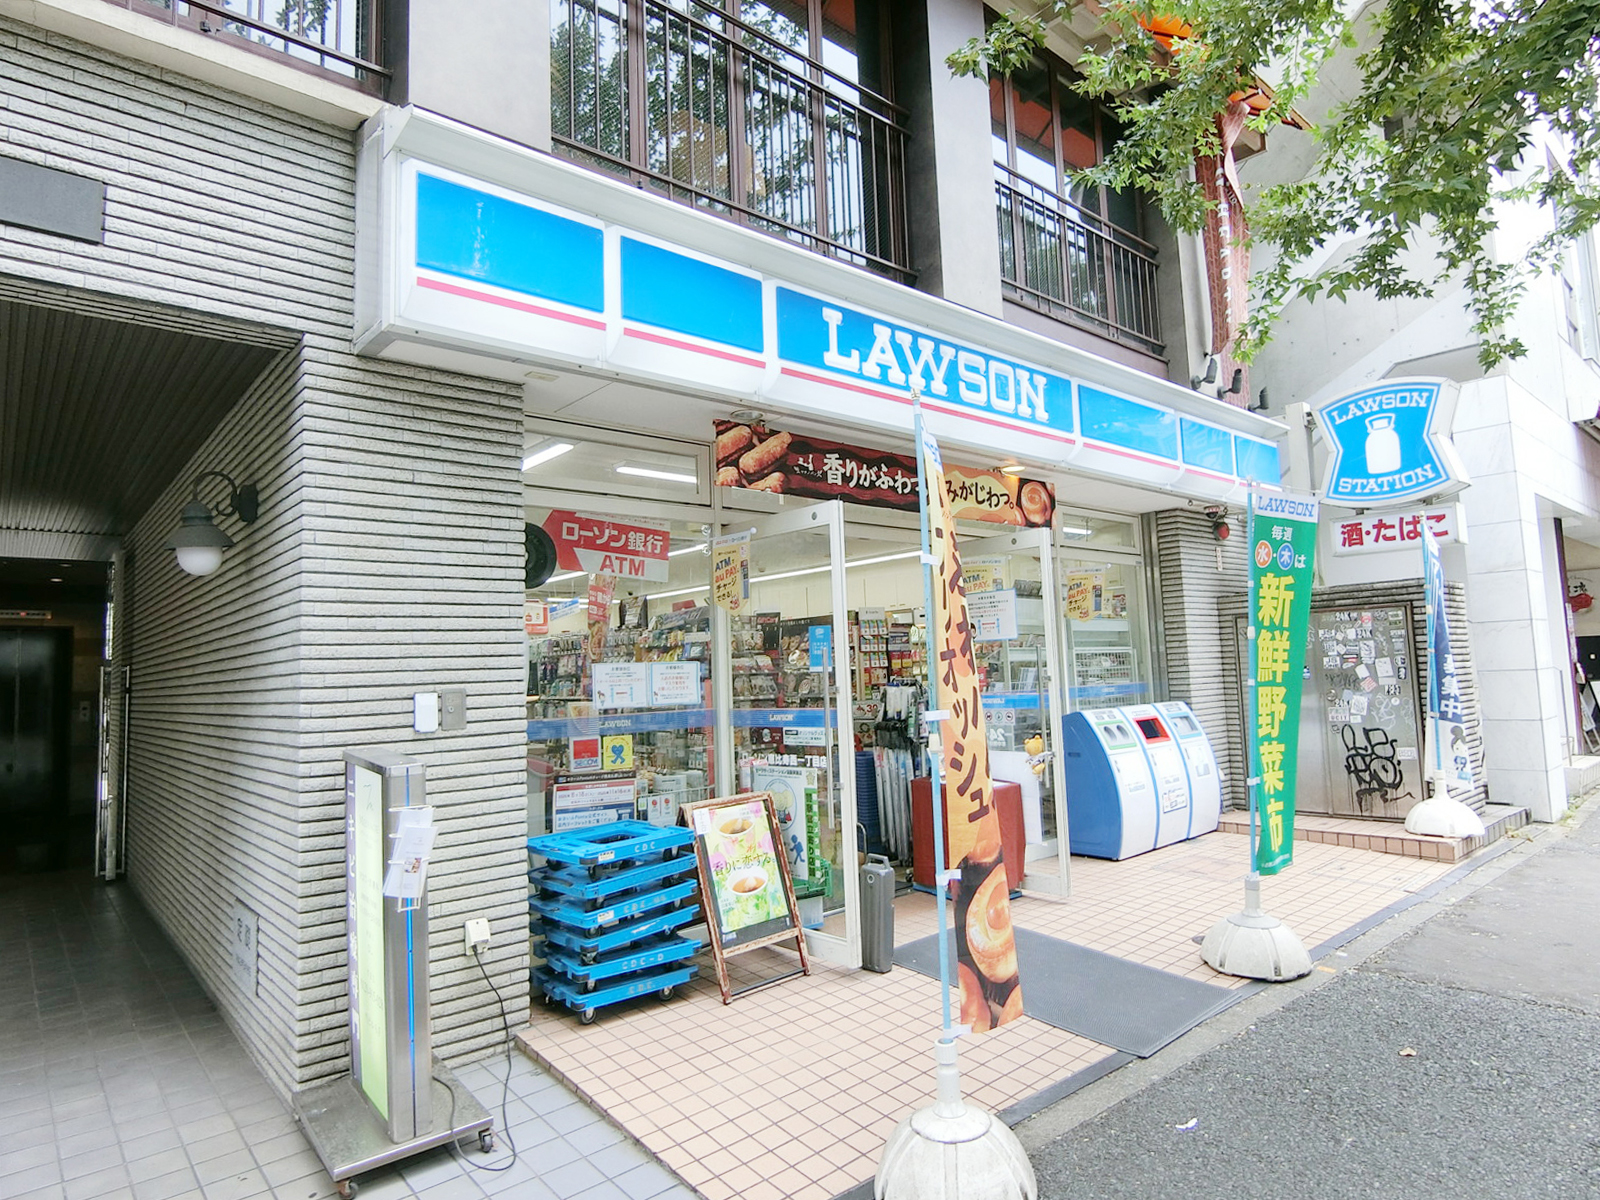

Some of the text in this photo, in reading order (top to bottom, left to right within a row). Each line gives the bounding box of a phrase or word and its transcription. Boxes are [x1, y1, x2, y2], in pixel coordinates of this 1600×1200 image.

[822, 307, 1049, 422] LAWSON
[1331, 392, 1429, 425] LAWSON
[1338, 463, 1436, 493] STATION
[1258, 496, 1315, 517] LAWSON
[562, 521, 663, 554] ローソン銀行
[1271, 525, 1294, 541] 毎週
[1341, 513, 1449, 548] 酒・たばこ
[600, 554, 645, 576] ATM
[1257, 572, 1296, 853] 新鮮野菜市
[574, 758, 598, 766] SECOM
